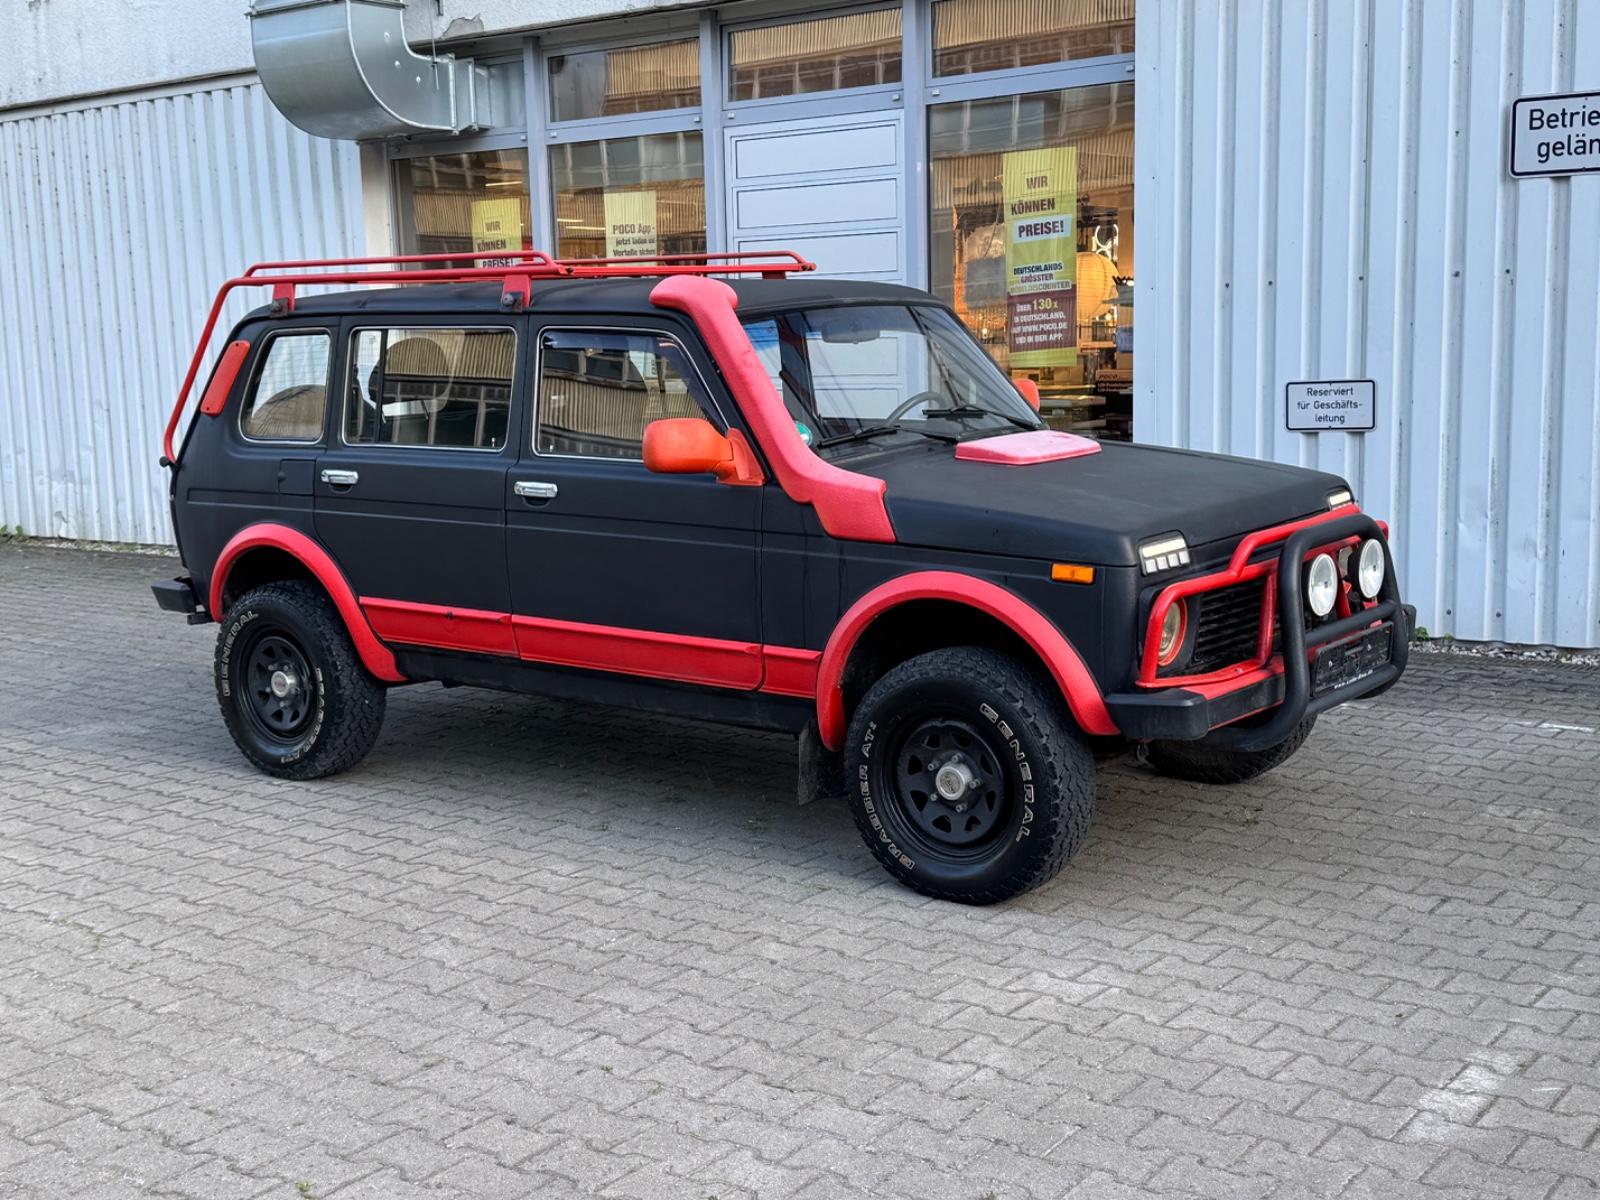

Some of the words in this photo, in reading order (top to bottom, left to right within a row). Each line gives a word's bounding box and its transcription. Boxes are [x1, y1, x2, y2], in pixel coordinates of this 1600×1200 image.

[1529, 105, 1600, 130] Betrie
[1537, 133, 1600, 164] gelän
[1026, 175, 1048, 190] WIR
[1010, 198, 1056, 216] KÖNNEN
[485, 220, 502, 232] WIR
[612, 223, 635, 235] POCO
[1018, 220, 1064, 238] PREISE!
[477, 239, 506, 252] KÖNNEN
[1013, 262, 1063, 276] DEUTSCHLANDS
[1032, 297, 1052, 311] 130
[1306, 386, 1354, 397] Reserviert
[1297, 400, 1310, 410] für
[1313, 399, 1363, 410] Geschäfts-
[1314, 413, 1346, 424] leitung
[979, 702, 1035, 842] GENERAL
[858, 764, 916, 870] GRABBER
